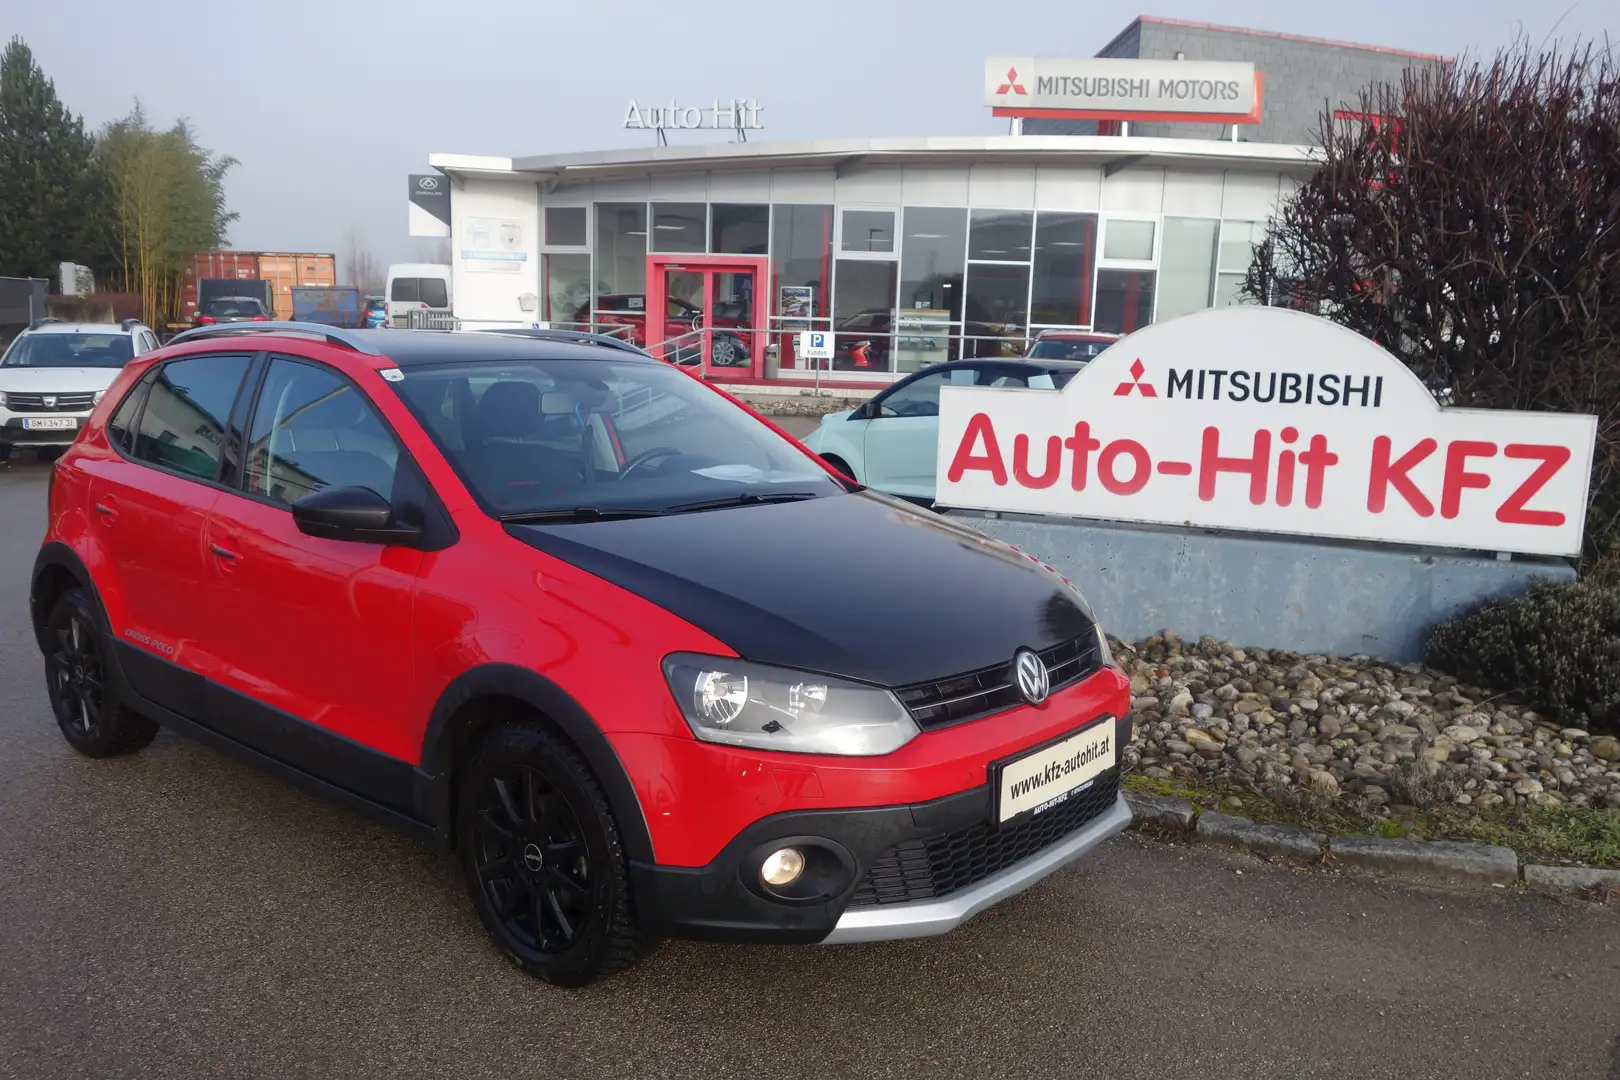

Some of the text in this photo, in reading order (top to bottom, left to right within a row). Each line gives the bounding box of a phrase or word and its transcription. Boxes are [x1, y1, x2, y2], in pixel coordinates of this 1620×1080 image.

[1036, 75, 1240, 101] MITSUBISHI MOTORS
[622, 97, 765, 129] Auto Hit
[1166, 367, 1384, 408] MITSUBISHI
[946, 412, 1572, 528] Auto-Hit KFZ
[1010, 735, 1110, 800] www.kfz-autohit.at
